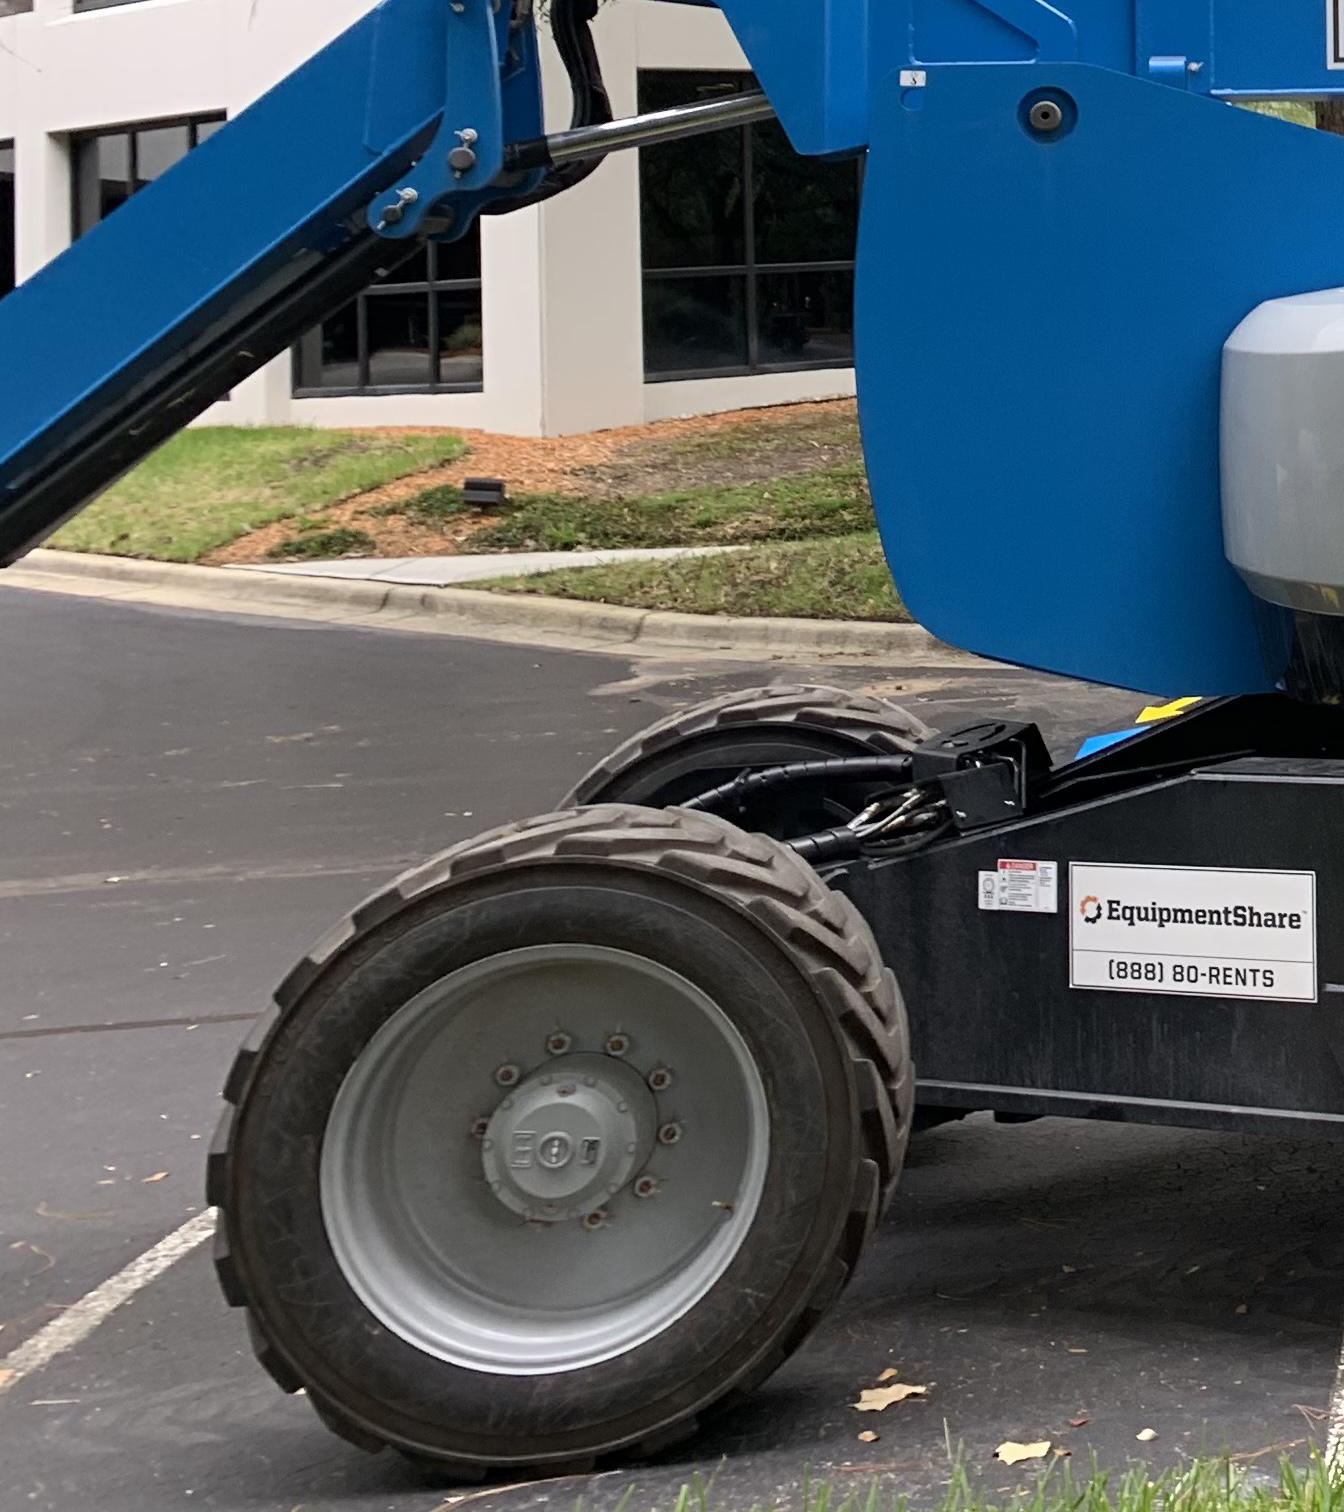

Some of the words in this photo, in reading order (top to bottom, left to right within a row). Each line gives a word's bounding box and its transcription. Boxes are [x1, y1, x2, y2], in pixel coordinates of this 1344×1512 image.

[1106, 899, 1302, 930] EquipmentShare
[1108, 959, 1164, 983] (888)
[1172, 965, 1275, 988] 80-RENTS
